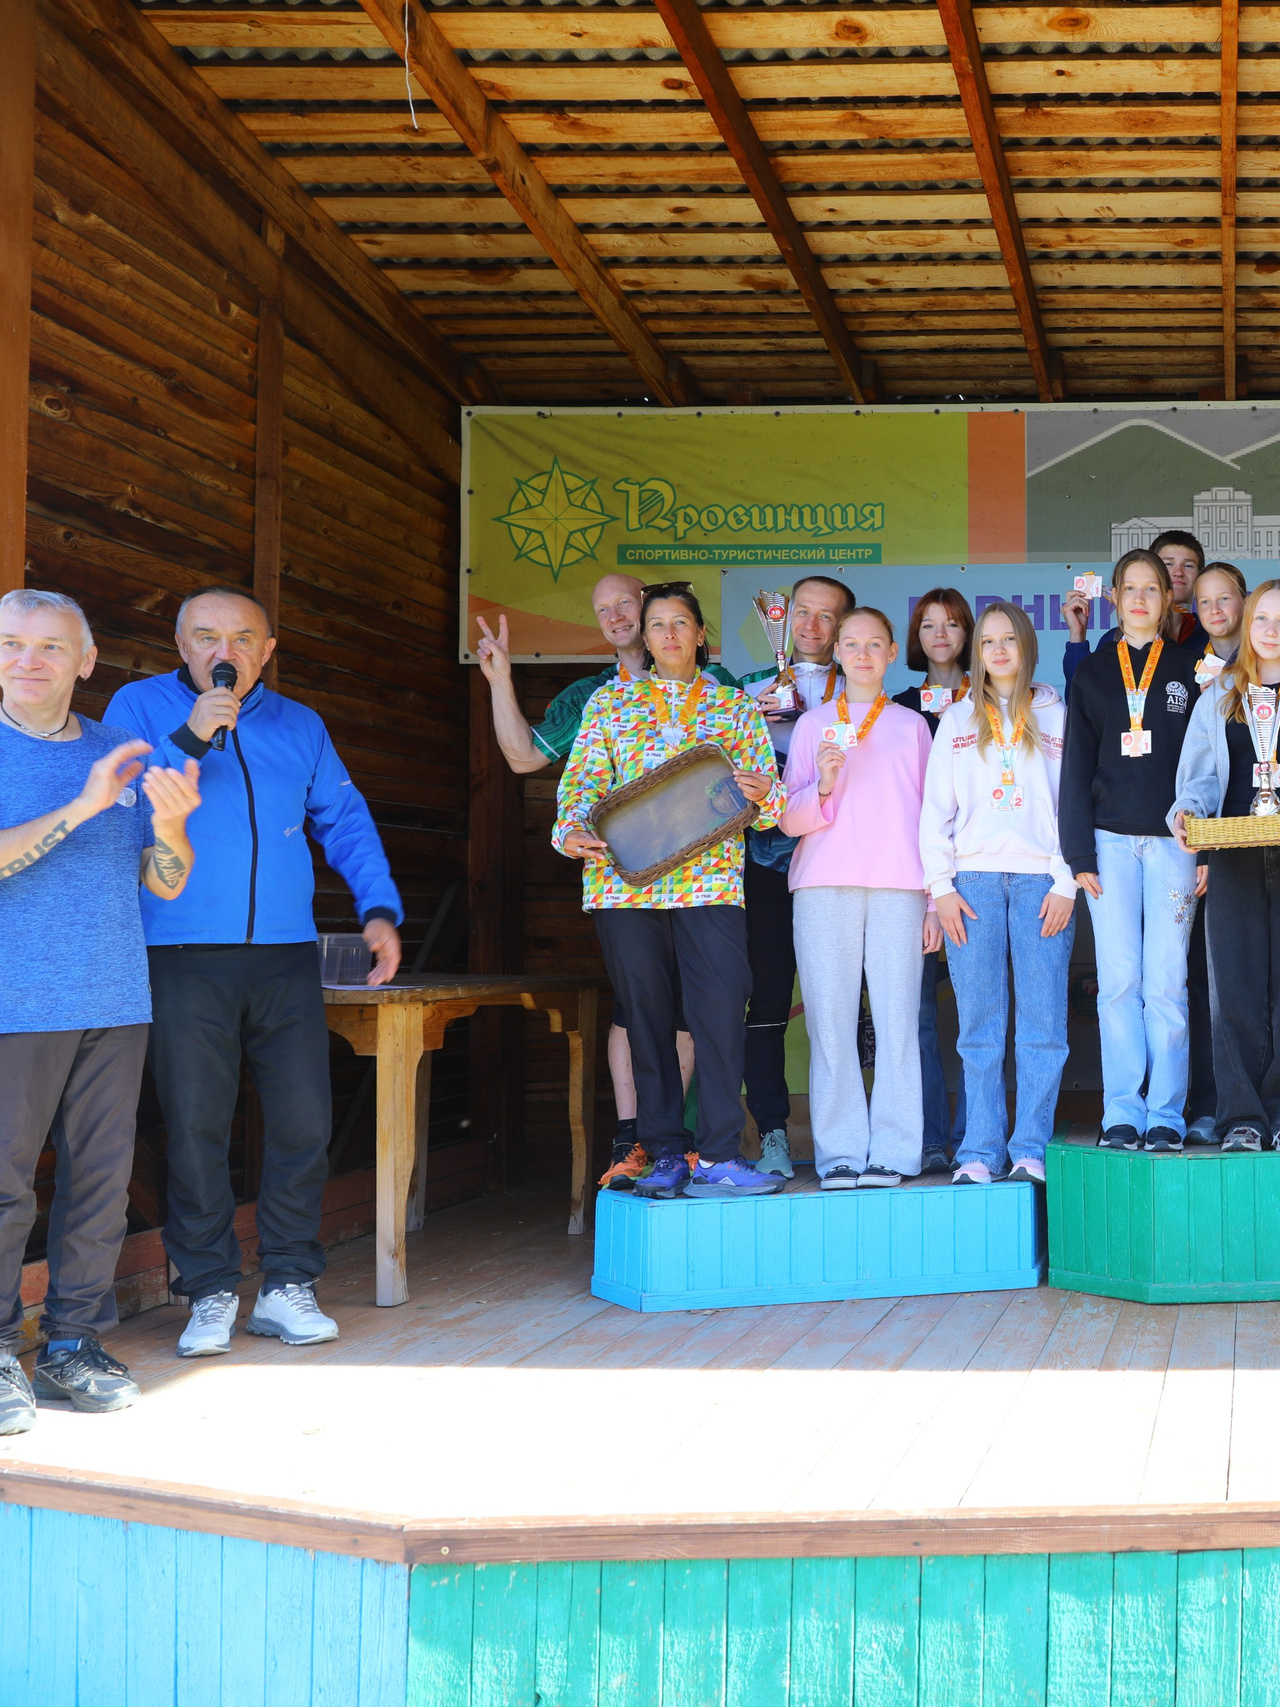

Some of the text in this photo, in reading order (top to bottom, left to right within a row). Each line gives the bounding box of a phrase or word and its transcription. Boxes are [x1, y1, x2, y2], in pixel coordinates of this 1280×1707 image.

[612, 477, 885, 542] Провинция
[626, 548, 873, 560] СПОРТИВНО-ТУРИСТИЧЕСКИЙ ЦЕНТР
[785, 700, 791, 708] 2
[848, 735, 857, 745] 2
[1015, 797, 1022, 807] 2
